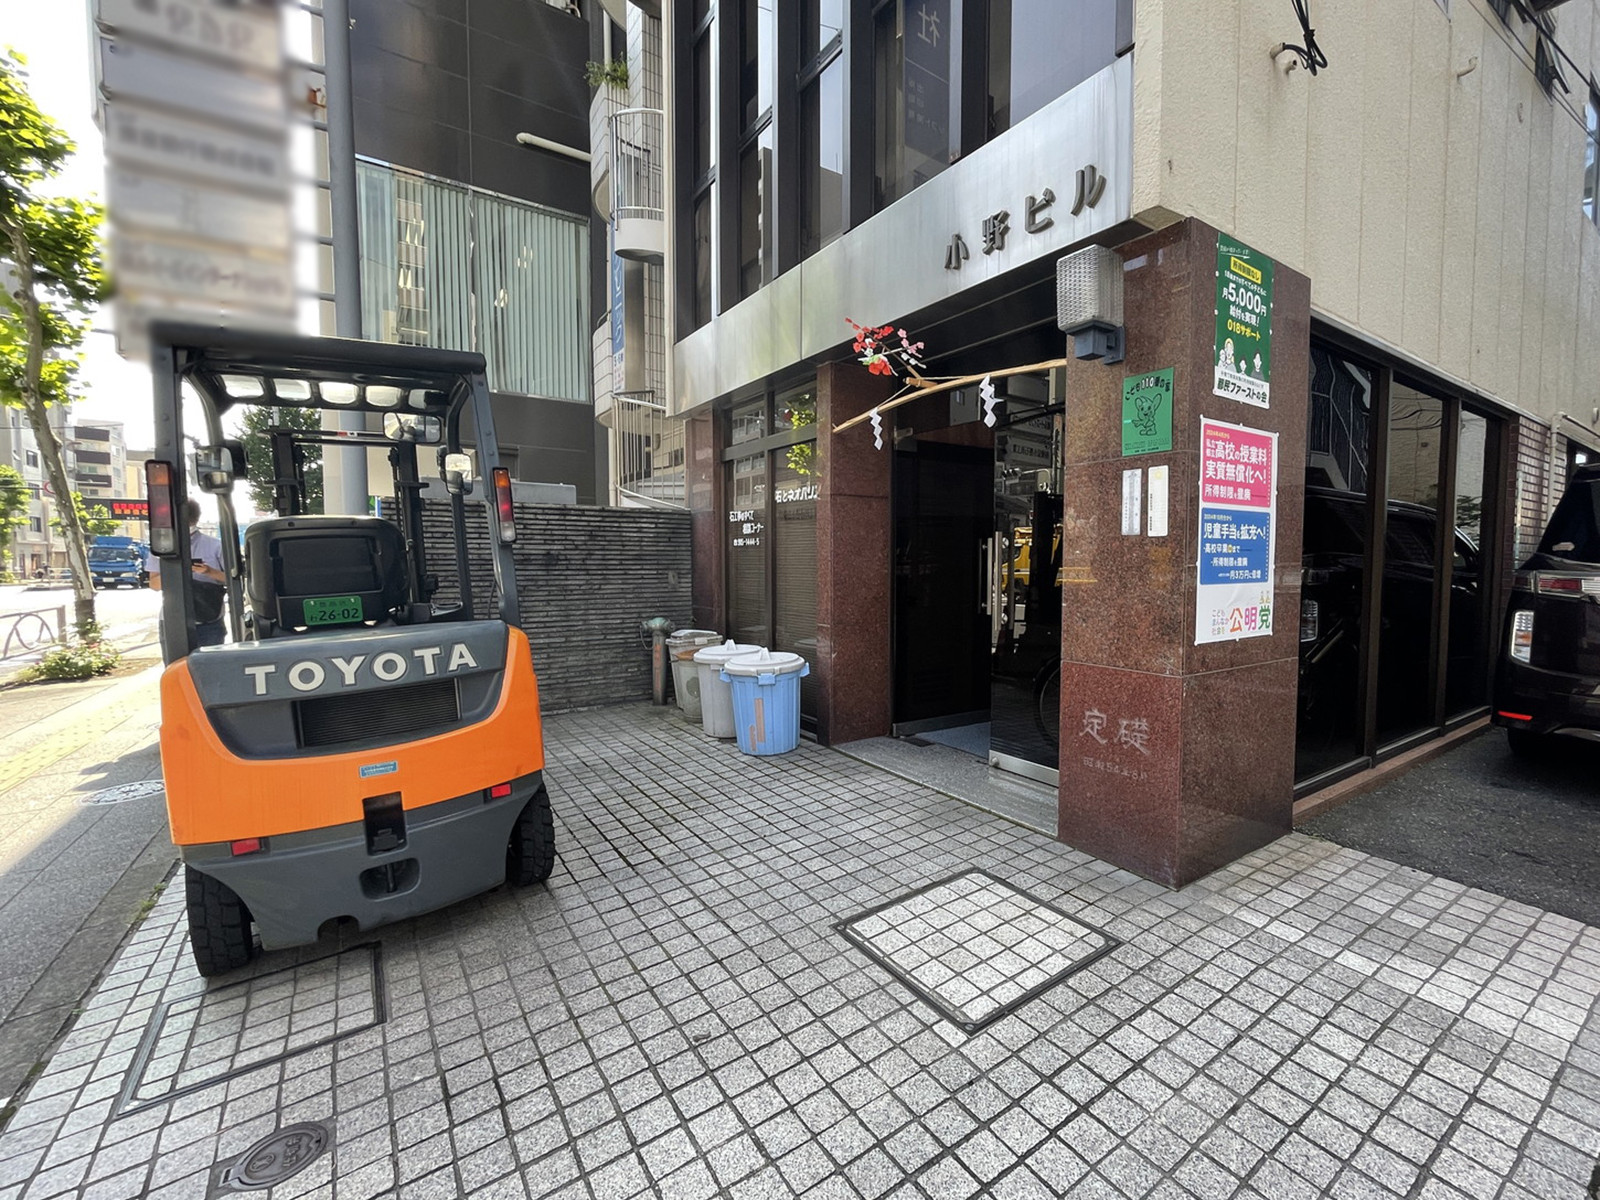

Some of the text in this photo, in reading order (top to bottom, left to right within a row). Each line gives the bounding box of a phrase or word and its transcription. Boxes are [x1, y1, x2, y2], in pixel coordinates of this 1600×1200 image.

[944, 163, 1108, 270] 小野ビル
[1222, 282, 1267, 316] 月5,000円
[1227, 319, 1261, 342] 018サポート
[1217, 377, 1267, 403] 都民ファーストの会
[1215, 440, 1267, 466] 高校の授業料
[1205, 460, 1267, 485] 実質無償化へ!
[1203, 522, 1266, 540] 児童手当を拡充へ!
[319, 608, 359, 621] 26-02
[1229, 604, 1271, 633] 公明党
[244, 642, 479, 696] TOYOTA
[1079, 707, 1151, 755] 定礎
